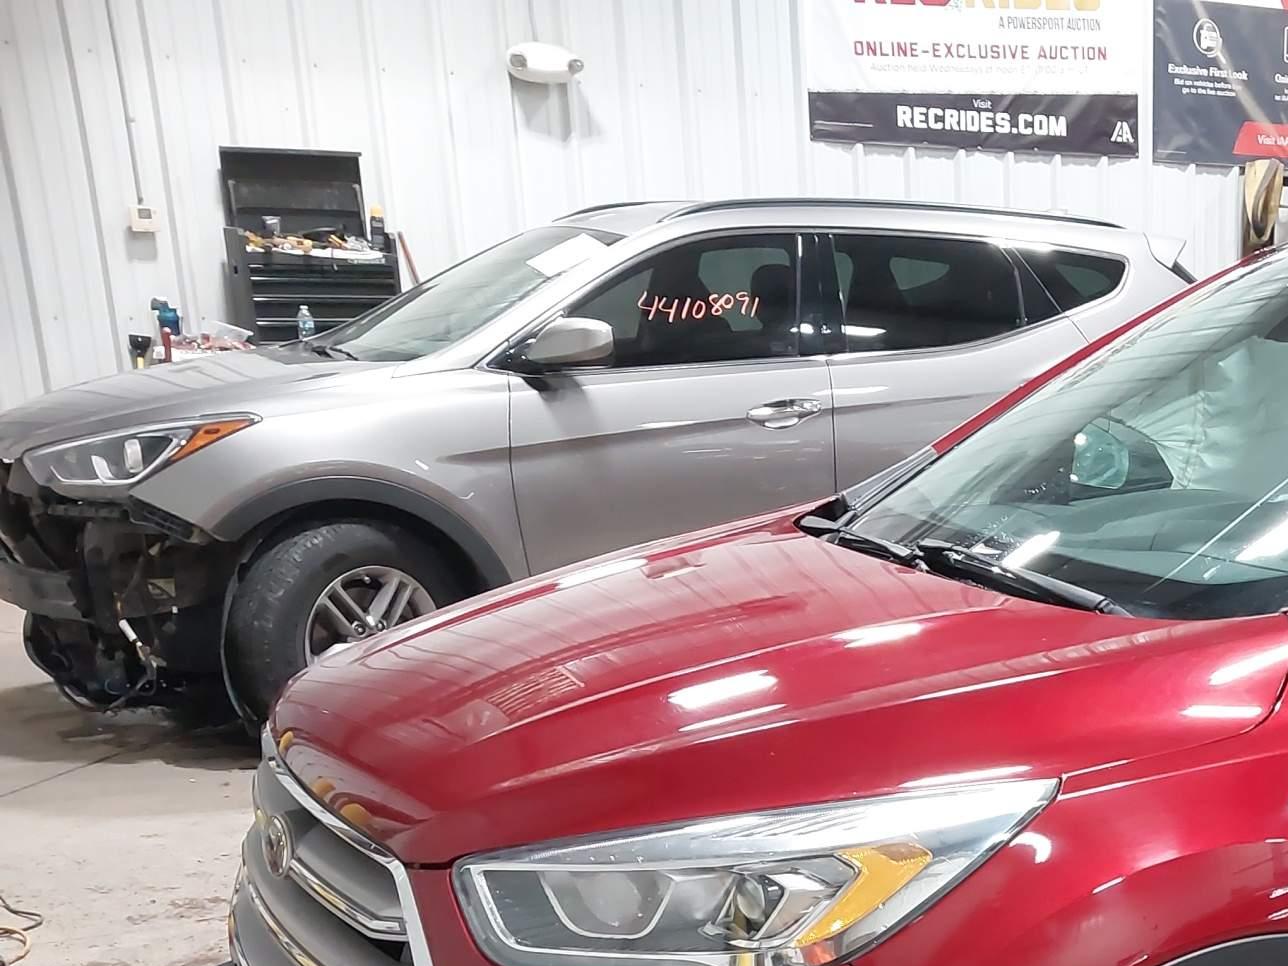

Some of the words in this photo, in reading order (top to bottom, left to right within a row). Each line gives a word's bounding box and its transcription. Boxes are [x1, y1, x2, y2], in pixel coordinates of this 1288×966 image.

[998, 16, 1005, 29] A
[1006, 16, 1064, 31] POWERSPORT
[1066, 18, 1101, 31] AUCTION
[853, 40, 1030, 60] ONLINE-EXCLUSIVE
[1037, 45, 1108, 61] AUCTION
[1168, 63, 1208, 76] Exclusive
[1209, 66, 1228, 78] First
[972, 98, 993, 109] Visit
[896, 104, 1067, 138] RECRIDES.COM
[1257, 134, 1276, 146] Visit
[637, 290, 761, 323] 44108091
